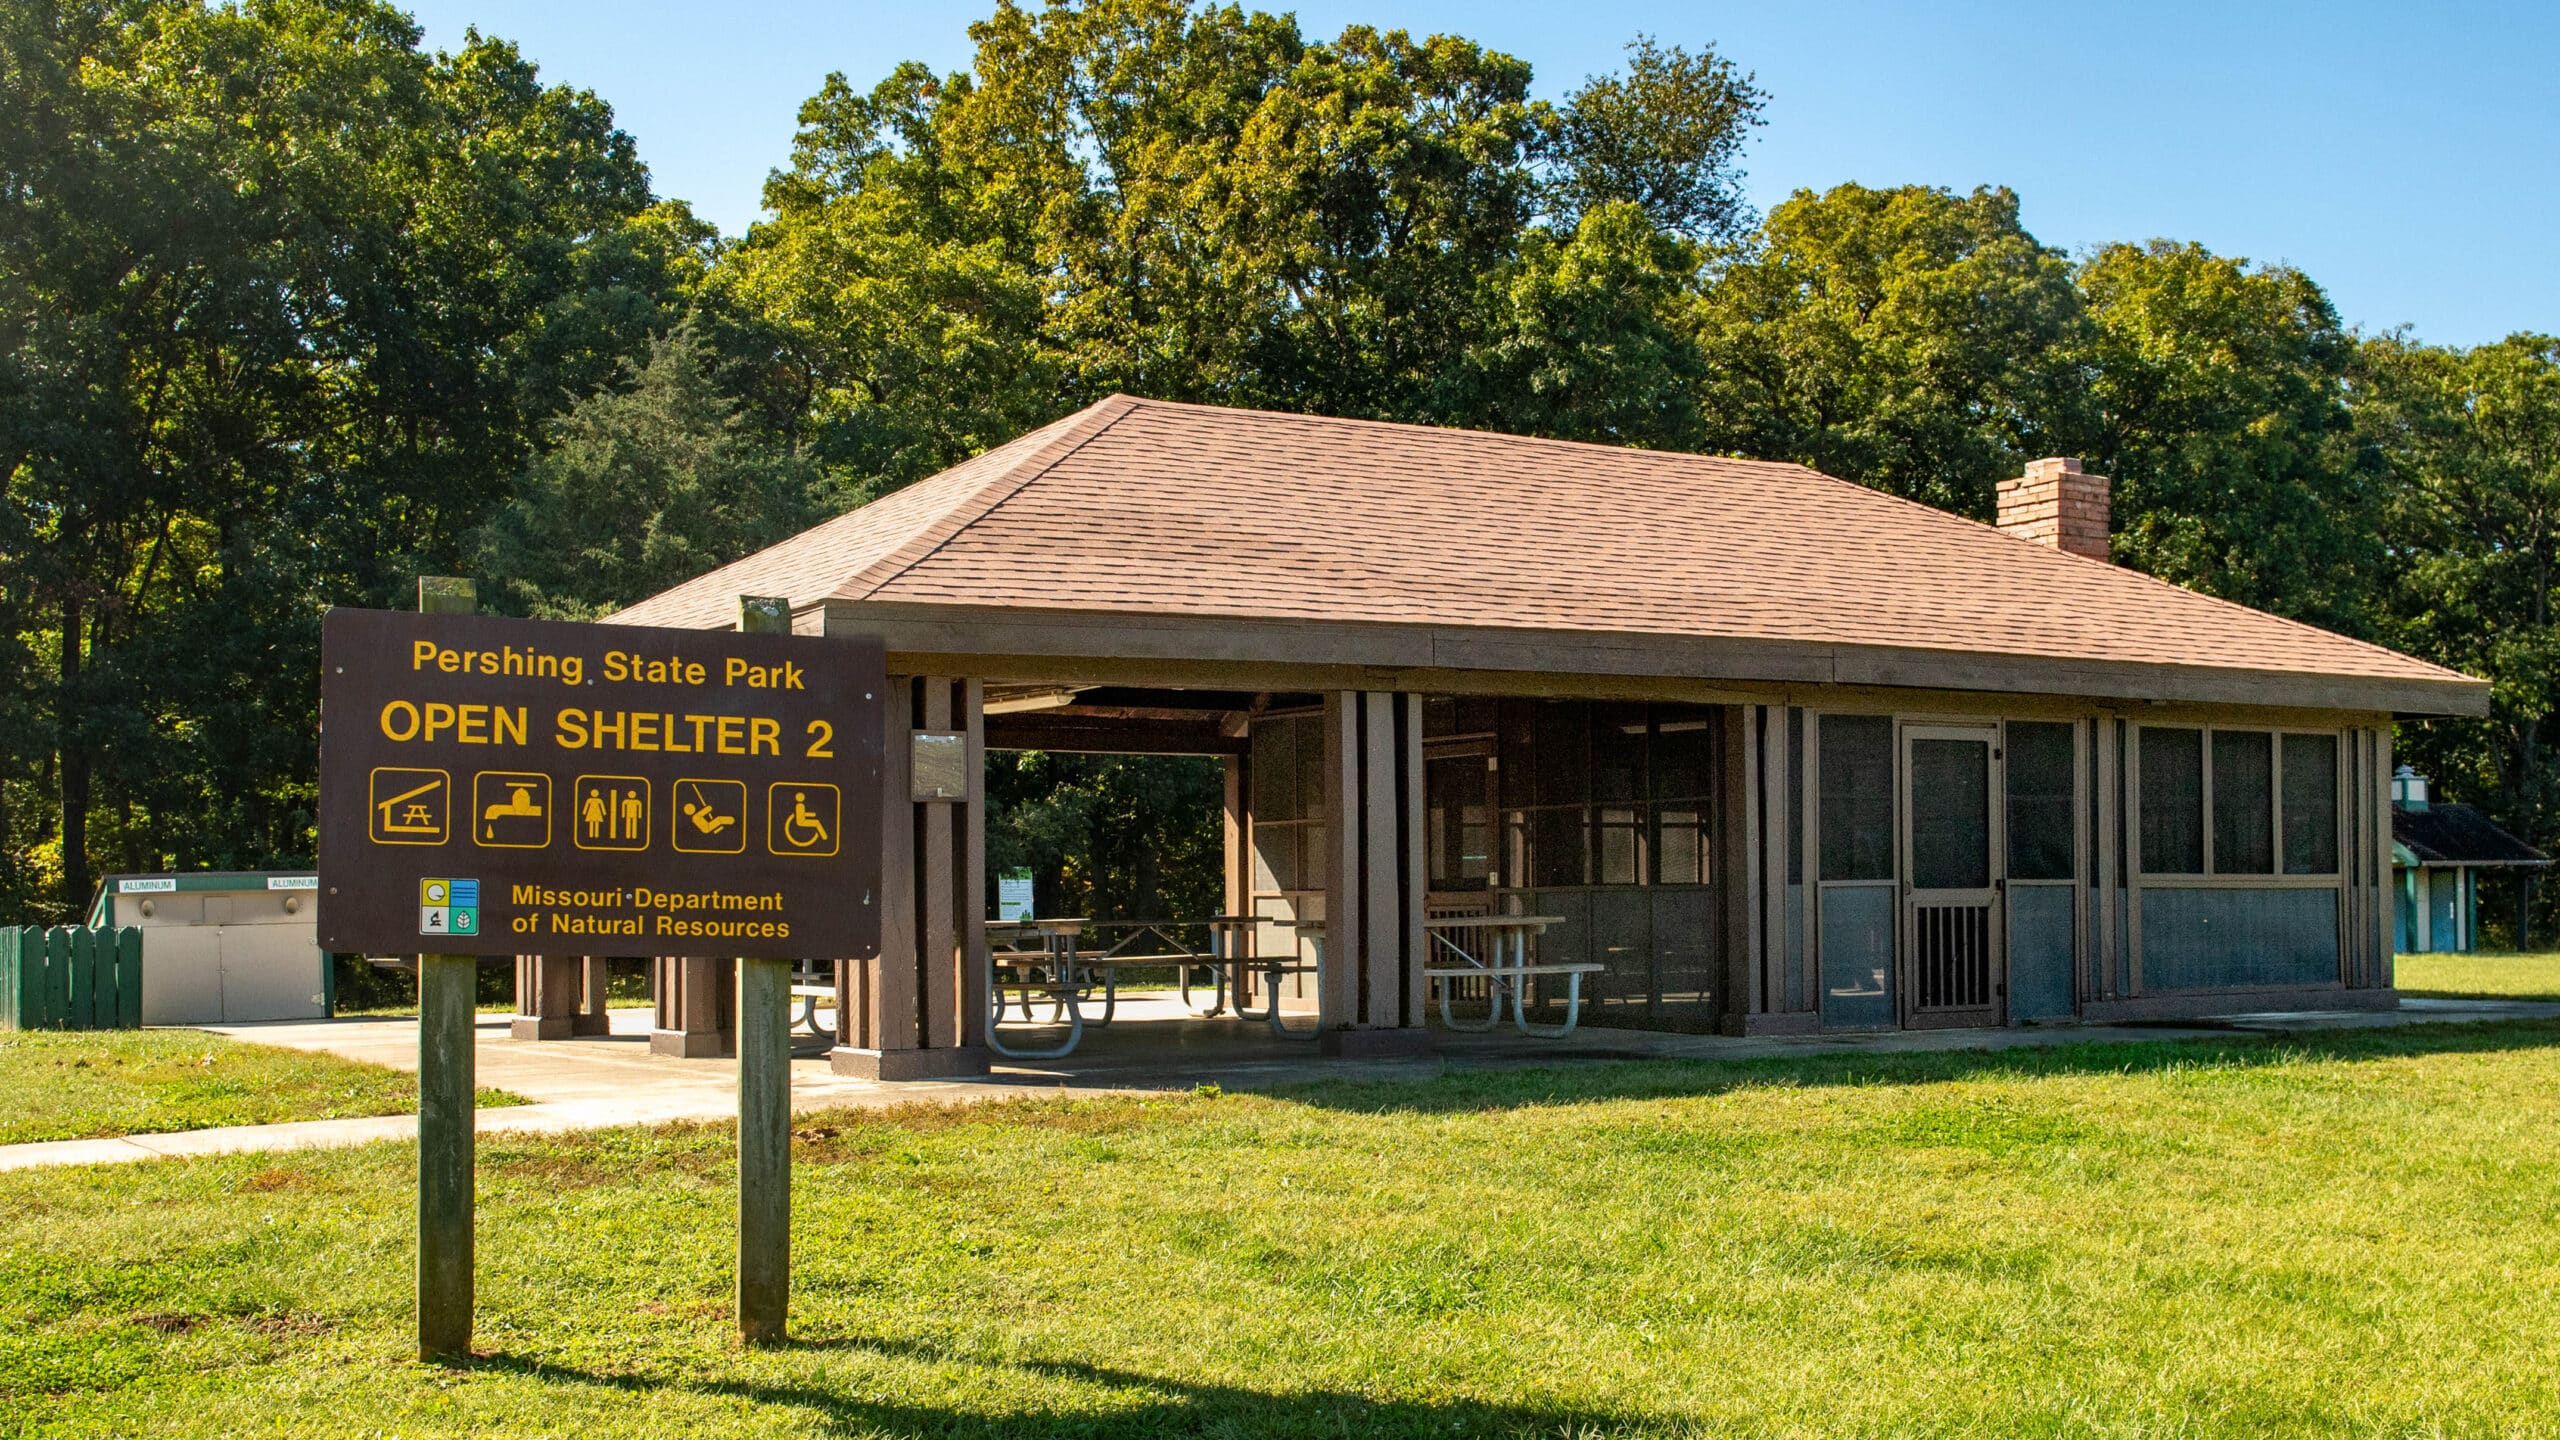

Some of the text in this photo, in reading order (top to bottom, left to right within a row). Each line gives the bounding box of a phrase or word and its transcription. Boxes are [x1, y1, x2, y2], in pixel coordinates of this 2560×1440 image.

[413, 640, 805, 690] Pershing State Park
[380, 700, 834, 758] OPEN SHELTER 2
[125, 881, 172, 890] ALUMINUM
[273, 879, 318, 888] ALUMINUM
[511, 884, 784, 912] Missouri Department
[511, 912, 791, 939] of Natural Resources
